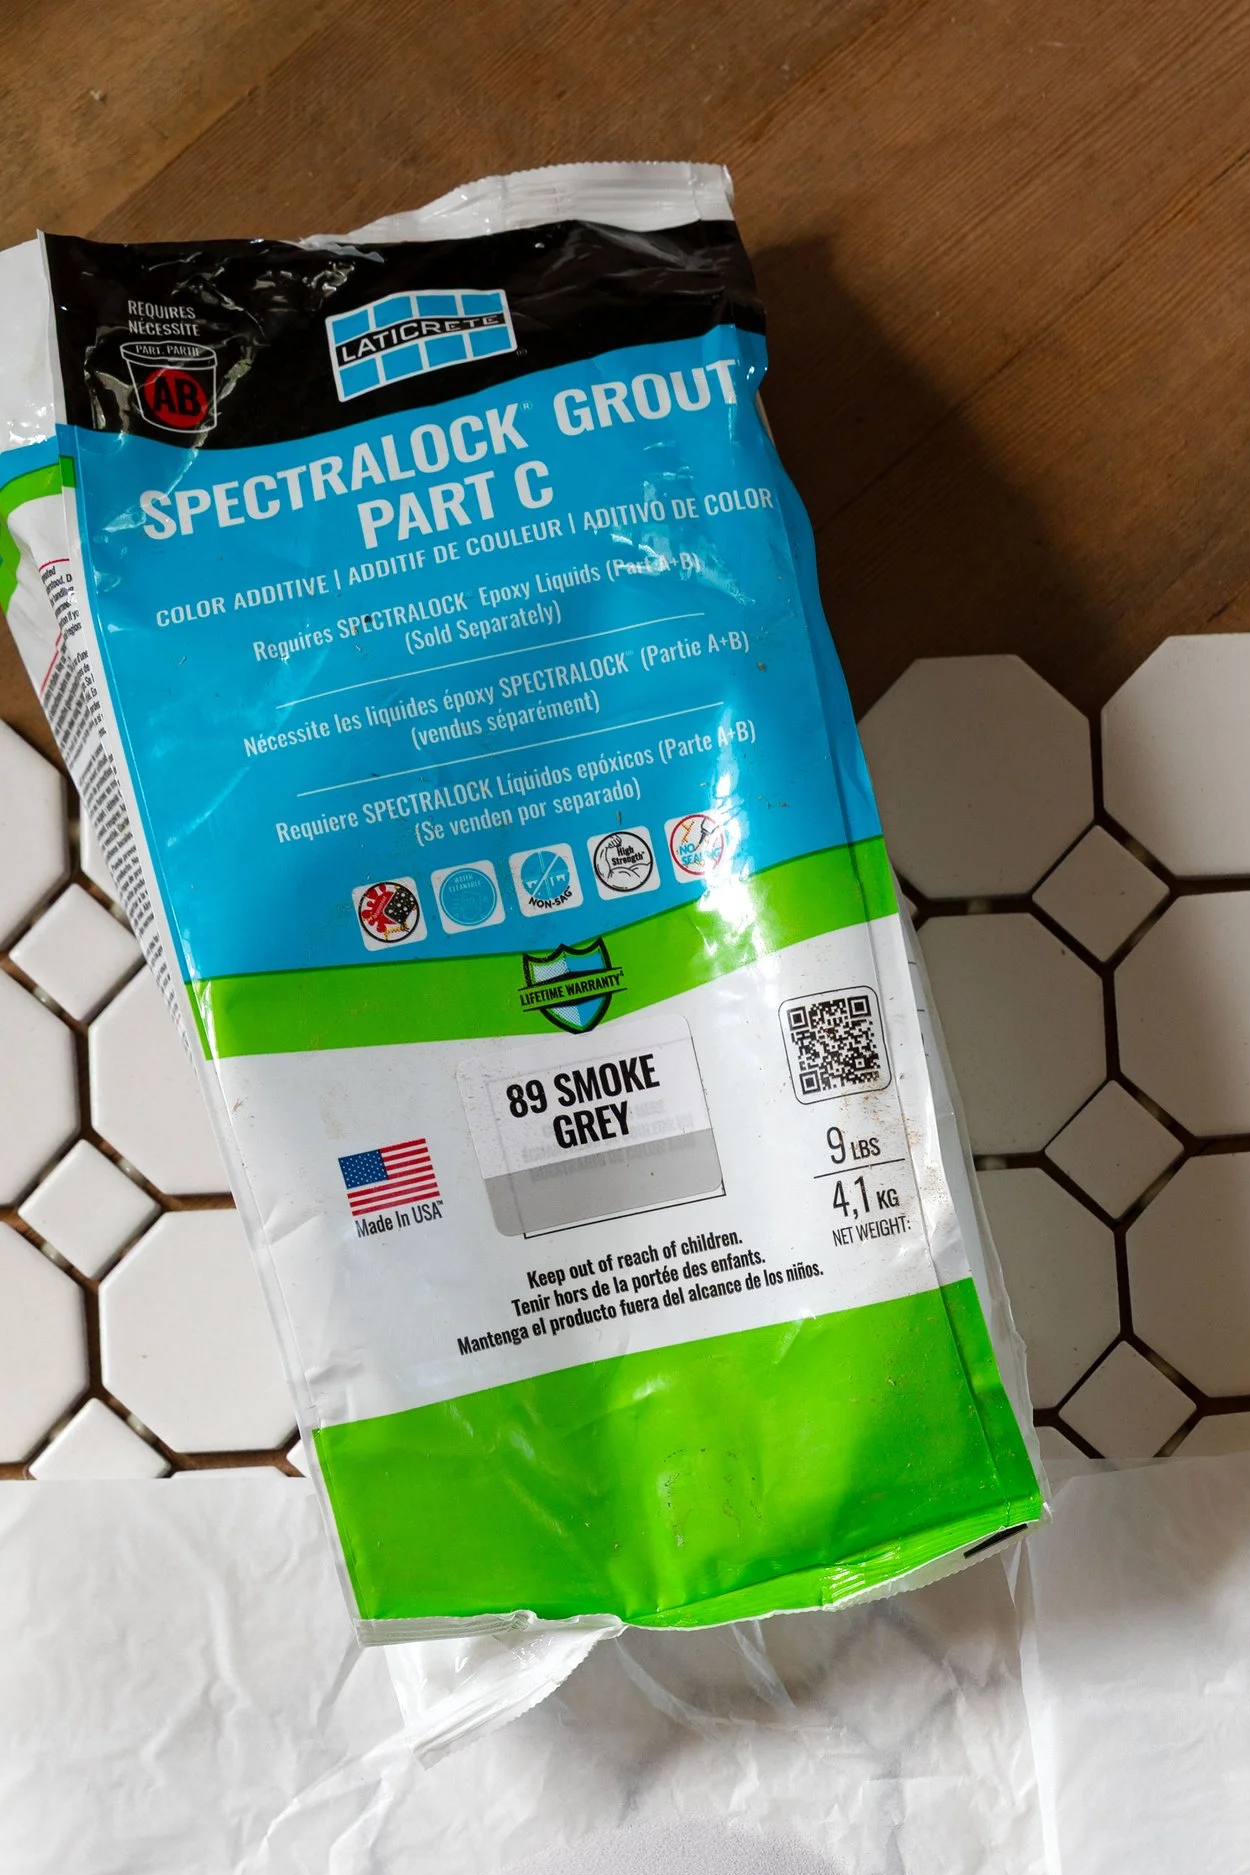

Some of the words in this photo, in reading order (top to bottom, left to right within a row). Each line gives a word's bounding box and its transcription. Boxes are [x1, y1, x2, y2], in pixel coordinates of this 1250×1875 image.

[128, 300, 196, 319] REQUIRES
[129, 318, 200, 336] NÉCESSITE
[342, 315, 499, 362] LATICRETE
[154, 376, 202, 416] AB
[555, 360, 740, 438] GROUT
[357, 471, 496, 549] PART
[514, 459, 554, 510] C
[155, 602, 227, 628] COLOR
[233, 576, 329, 611] ADDITIVE
[347, 554, 427, 587] ADDITIF
[434, 543, 461, 563] DE
[466, 518, 564, 558] COULEUR
[583, 499, 665, 531] ADITIVO
[672, 497, 699, 520] DE
[704, 488, 773, 516] COLOR
[253, 625, 333, 662] Requires
[478, 580, 532, 609] Epoxy
[536, 563, 601, 596] Liquids
[404, 630, 452, 655] (Sold
[456, 600, 562, 642] Separately)
[244, 720, 331, 758] Nécessite
[336, 713, 363, 733] les
[366, 694, 439, 728] liquides
[443, 684, 495, 713] époxy
[640, 639, 702, 672] (Partie
[707, 630, 750, 655] A+B)
[410, 719, 483, 750] (vendus
[486, 689, 601, 729] séparément)
[275, 808, 359, 843] Requiere
[362, 782, 494, 824] SPECTRALOCK
[577, 748, 655, 785] epóxicos
[658, 731, 713, 763] (Parte
[451, 807, 515, 834] venden
[518, 800, 549, 825] por
[553, 776, 642, 815] separado)
[617, 846, 634, 857] High
[529, 888, 573, 908] NON-SAG
[520, 986, 565, 1006] LIFETIME
[506, 1079, 548, 1119] 89
[553, 1053, 660, 1107] SMOKE
[553, 1101, 633, 1149] GREY
[826, 1126, 847, 1164] 9
[851, 1137, 881, 1160] LBS
[832, 1175, 871, 1219] 4,1
[876, 1188, 900, 1209] KG
[355, 1212, 393, 1238] Made
[832, 1227, 854, 1247] NET
[856, 1215, 911, 1242] WEIGHT:
[511, 1295, 551, 1317] Tenir
[554, 1285, 589, 1307] hors
[591, 1281, 611, 1298] de
[613, 1278, 629, 1294] la
[632, 1265, 679, 1291] portée
[682, 1259, 708, 1278] des
[711, 1249, 766, 1273] enfants.
[526, 1269, 566, 1289] Keep
[569, 1259, 595, 1280] out
[598, 1254, 613, 1272] of
[617, 1245, 659, 1269] reach
[662, 1240, 678, 1259] of
[680, 1230, 743, 1256] children.
[456, 1325, 530, 1355] Mantenga
[532, 1318, 547, 1336] el
[550, 1304, 618, 1335] producto
[620, 1294, 659, 1316] fuera
[662, 1289, 685, 1307] del
[688, 1277, 742, 1302] alcance
[745, 1272, 762, 1290] de
[764, 1268, 784, 1286] los
[786, 1261, 824, 1282] niños.
